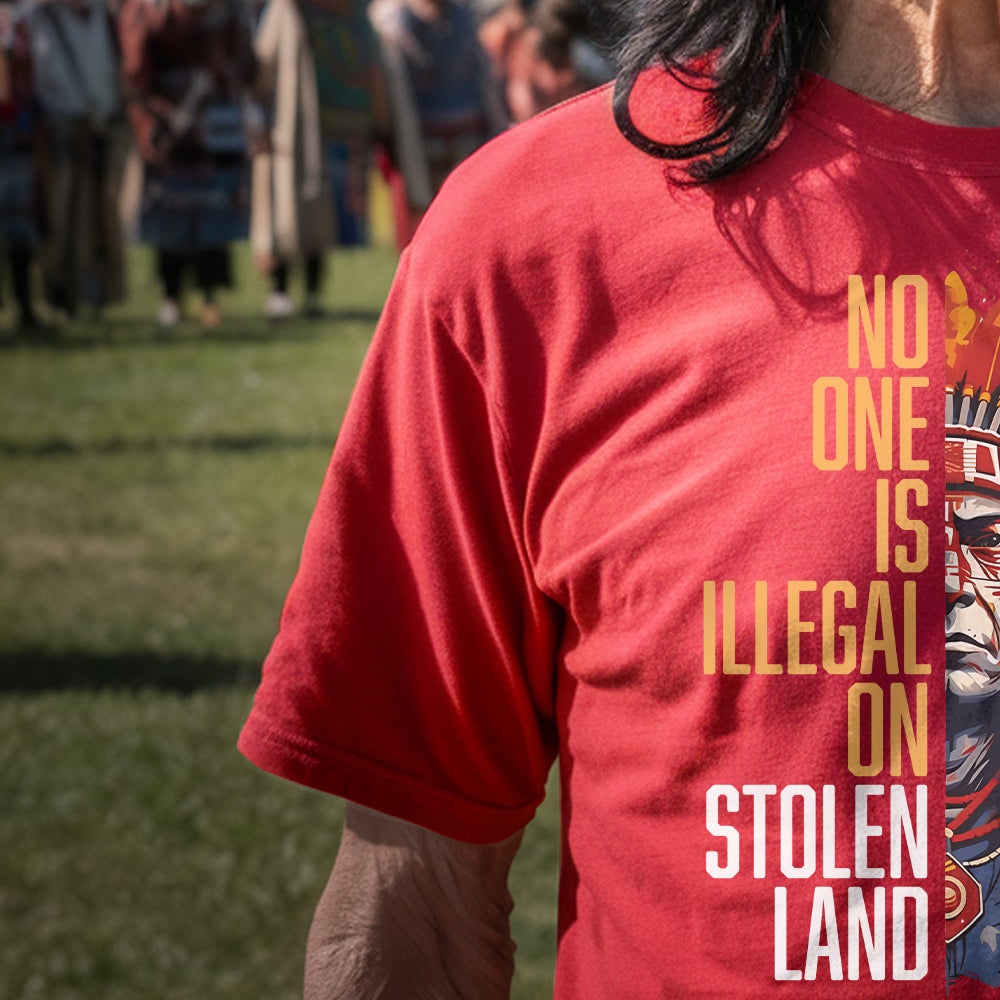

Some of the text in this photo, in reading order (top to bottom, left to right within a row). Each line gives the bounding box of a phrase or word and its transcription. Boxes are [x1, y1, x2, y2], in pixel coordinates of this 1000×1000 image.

[847, 274, 927, 368] NO
[812, 376, 929, 471] ONE
[876, 479, 928, 573] IS
[702, 580, 931, 675] ILLEGAL
[847, 683, 927, 776] ON
[706, 784, 927, 879] STOLEN
[774, 886, 928, 980] LAND
